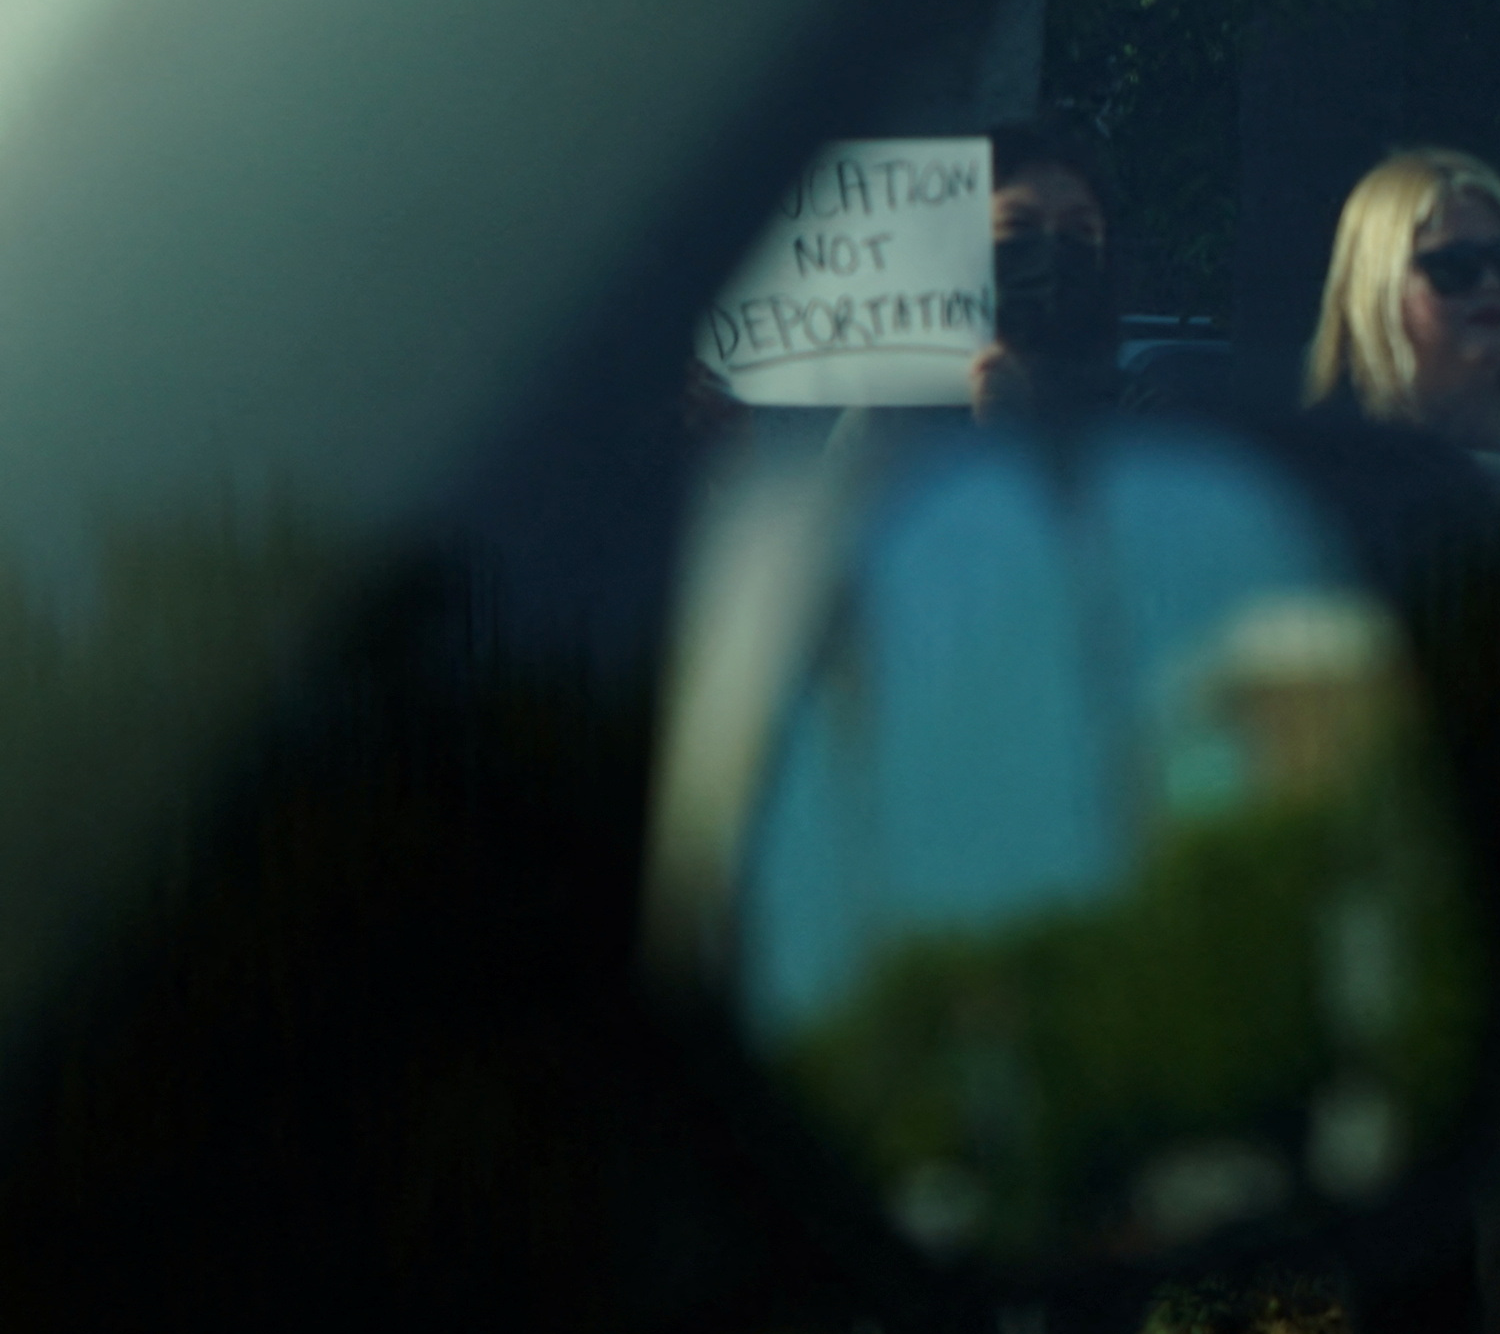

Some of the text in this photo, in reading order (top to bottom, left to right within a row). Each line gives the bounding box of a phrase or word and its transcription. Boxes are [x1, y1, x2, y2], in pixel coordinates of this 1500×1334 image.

[779, 157, 981, 220] UCATION
[794, 230, 895, 279] NOT
[709, 283, 996, 362] DEPORTATION
